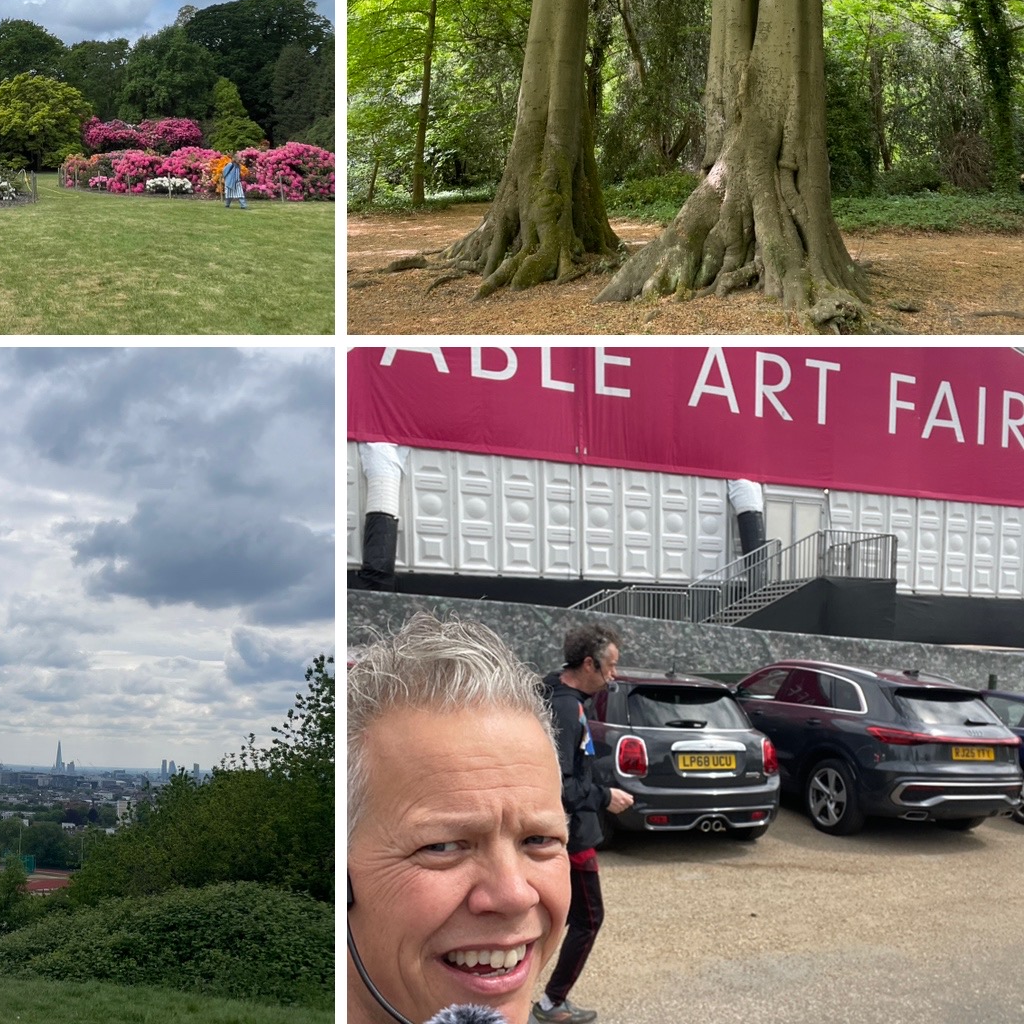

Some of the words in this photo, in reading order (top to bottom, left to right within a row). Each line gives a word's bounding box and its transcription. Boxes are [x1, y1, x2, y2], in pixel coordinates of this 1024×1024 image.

[687, 347, 841, 425] ART
[888, 372, 1024, 450] FAIR
[682, 756, 710, 767] LP68
[712, 756, 732, 767] UCU
